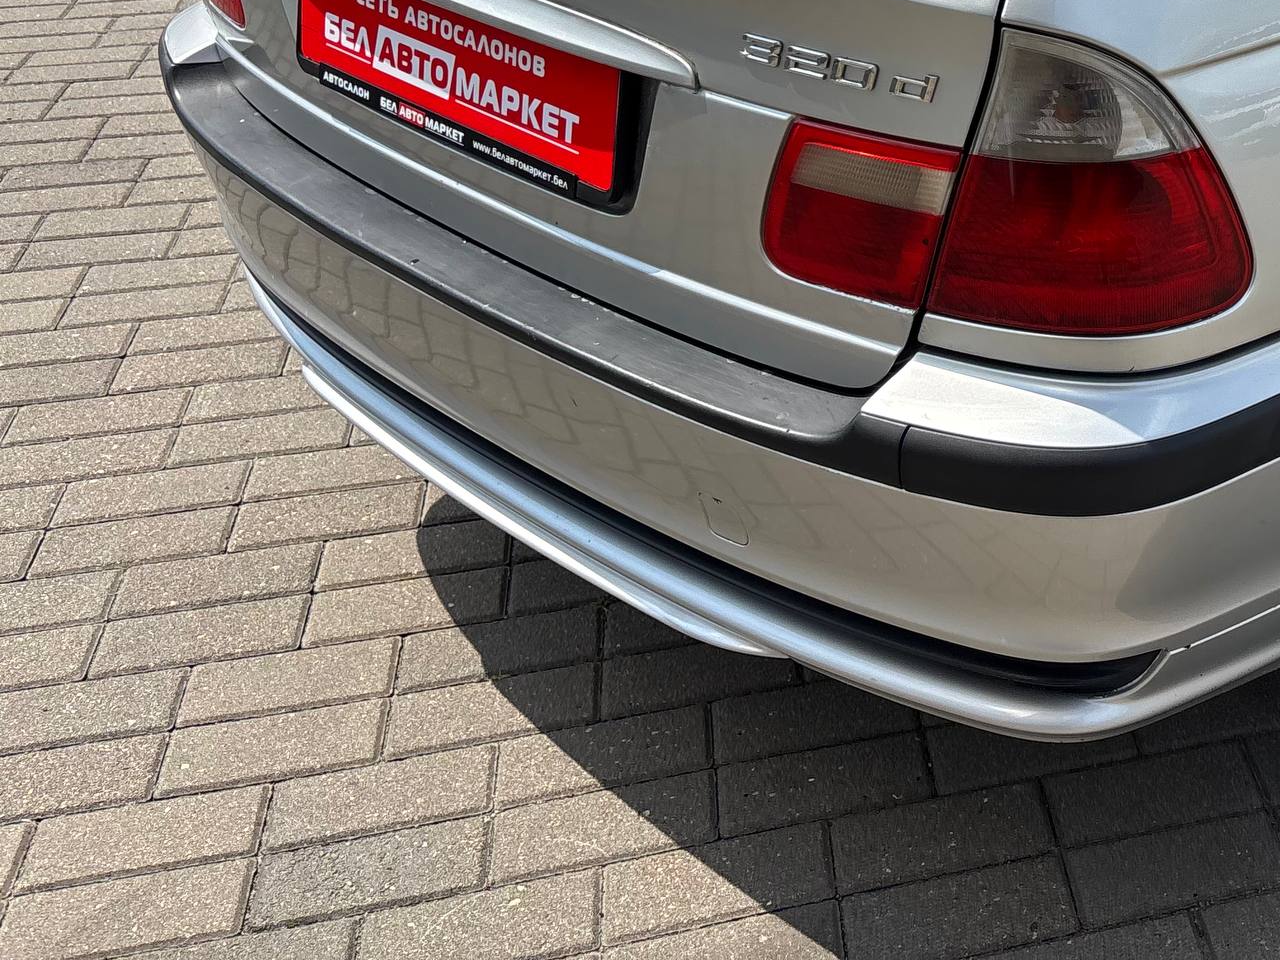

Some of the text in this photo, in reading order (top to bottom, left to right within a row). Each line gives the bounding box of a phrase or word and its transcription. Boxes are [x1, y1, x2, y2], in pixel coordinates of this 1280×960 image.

[404, 5, 545, 77] АВТОСАЛОНОВ
[323, 71, 370, 100] АВТОСАЛОН
[472, 139, 568, 190] www.белавтомаркет.бел
